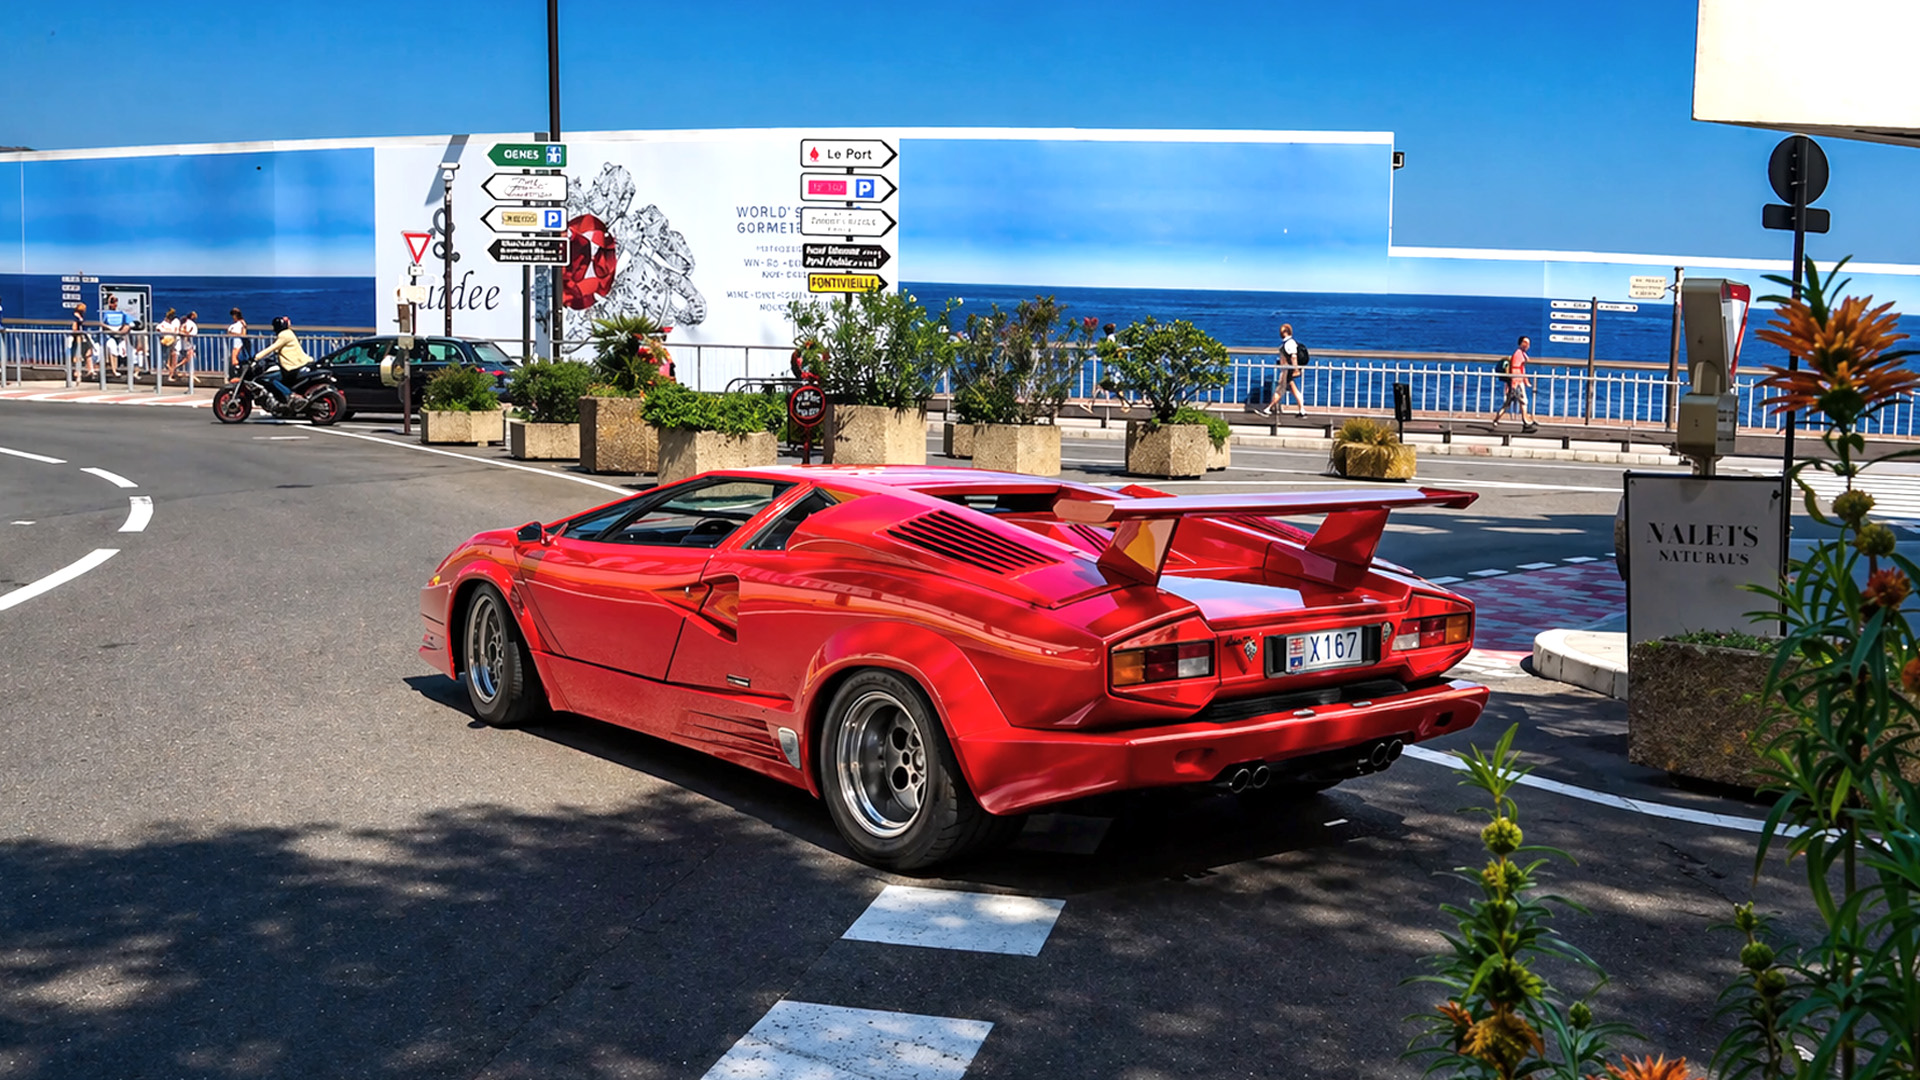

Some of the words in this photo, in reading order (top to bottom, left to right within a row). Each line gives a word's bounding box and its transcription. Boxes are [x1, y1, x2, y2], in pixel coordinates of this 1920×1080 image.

[827, 148, 842, 160] Le
[846, 147, 872, 160] Port
[1309, 631, 1358, 662] X167
